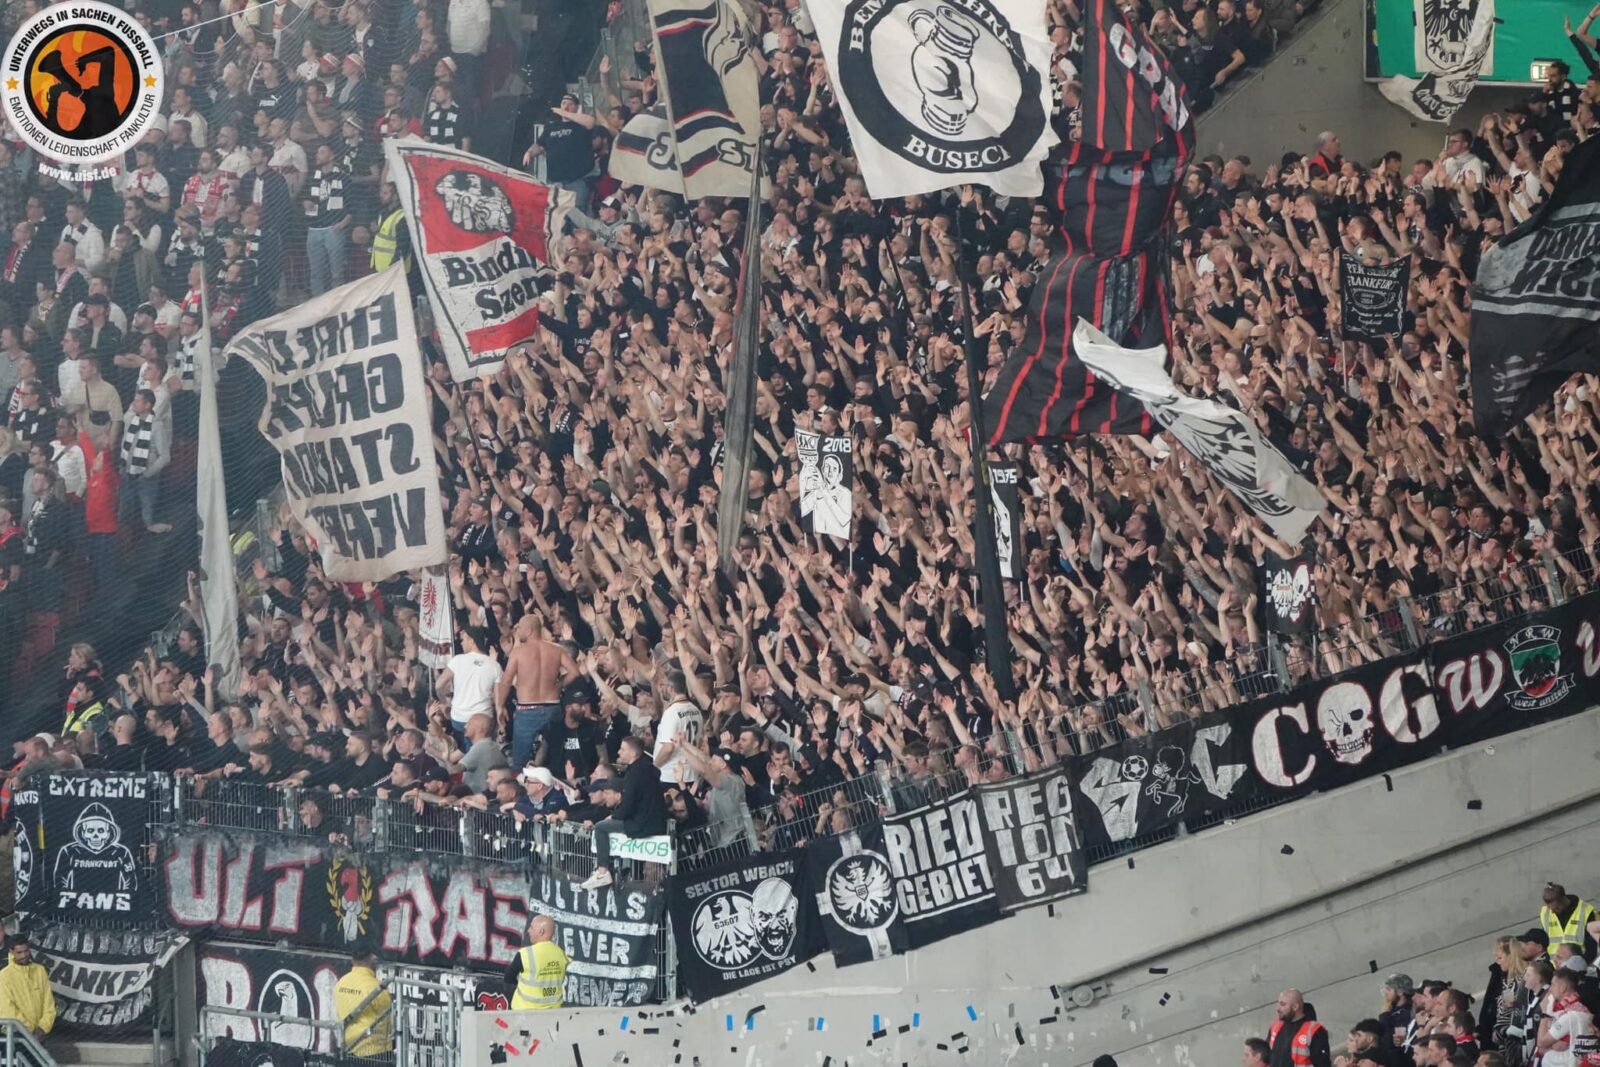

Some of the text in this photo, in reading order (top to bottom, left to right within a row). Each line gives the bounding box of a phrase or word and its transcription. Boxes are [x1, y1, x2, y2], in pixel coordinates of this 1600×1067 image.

[822, 437, 852, 453] 2018
[992, 468, 1018, 484] 1975
[49, 774, 147, 799] EXTREME
[981, 775, 1073, 831] REG
[883, 799, 985, 878] RIED
[995, 812, 1081, 867] ION
[685, 860, 794, 899] SEKTOR WBACH
[896, 854, 995, 916] GEBIET
[1016, 855, 1075, 898] 64
[58, 891, 131, 911] FANS
[541, 874, 647, 920] ULTRAS
[552, 924, 630, 964] EVER
[722, 970, 737, 981] DIE
[762, 964, 776, 973] IST
[779, 955, 797, 968] PSY
